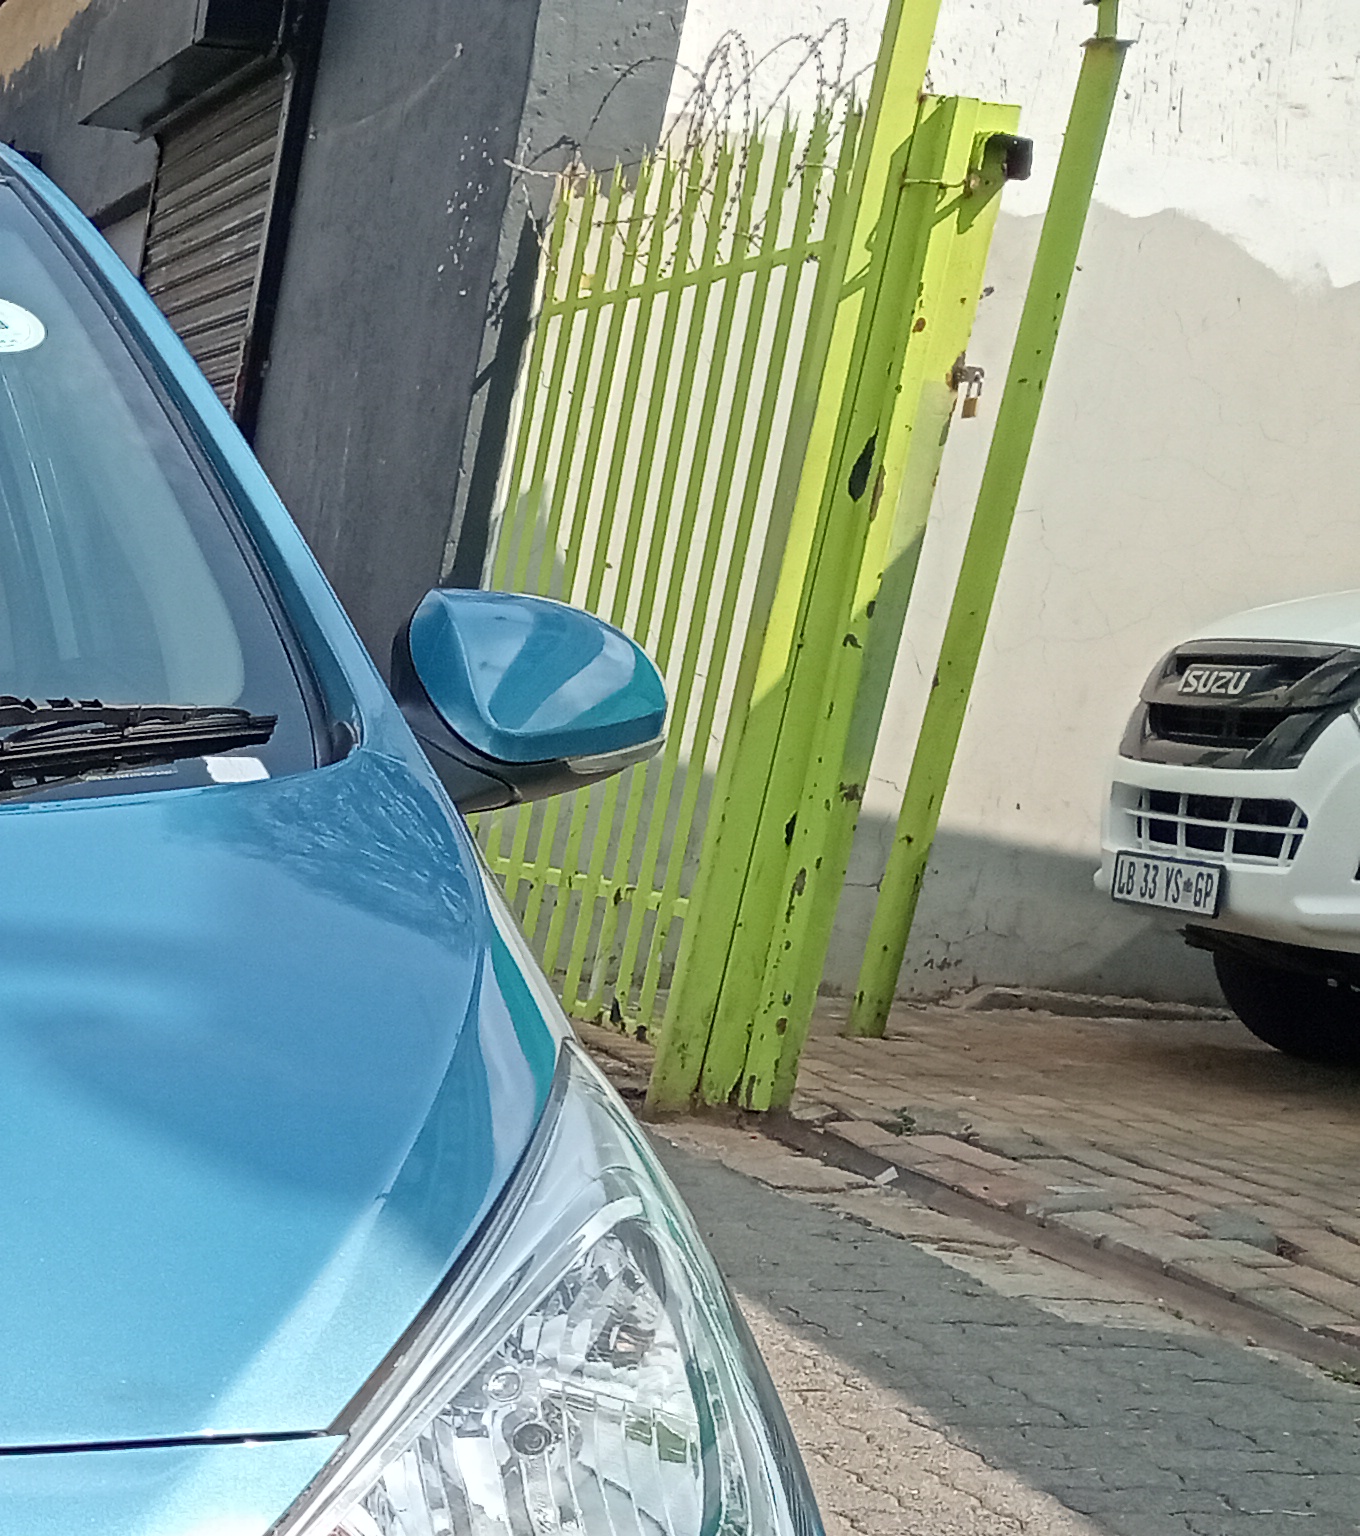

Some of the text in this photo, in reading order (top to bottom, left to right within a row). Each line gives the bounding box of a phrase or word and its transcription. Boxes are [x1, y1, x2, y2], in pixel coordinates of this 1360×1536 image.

[1178, 669, 1251, 695] ISUZU
[1117, 860, 1214, 908] LB 33 YS GP
